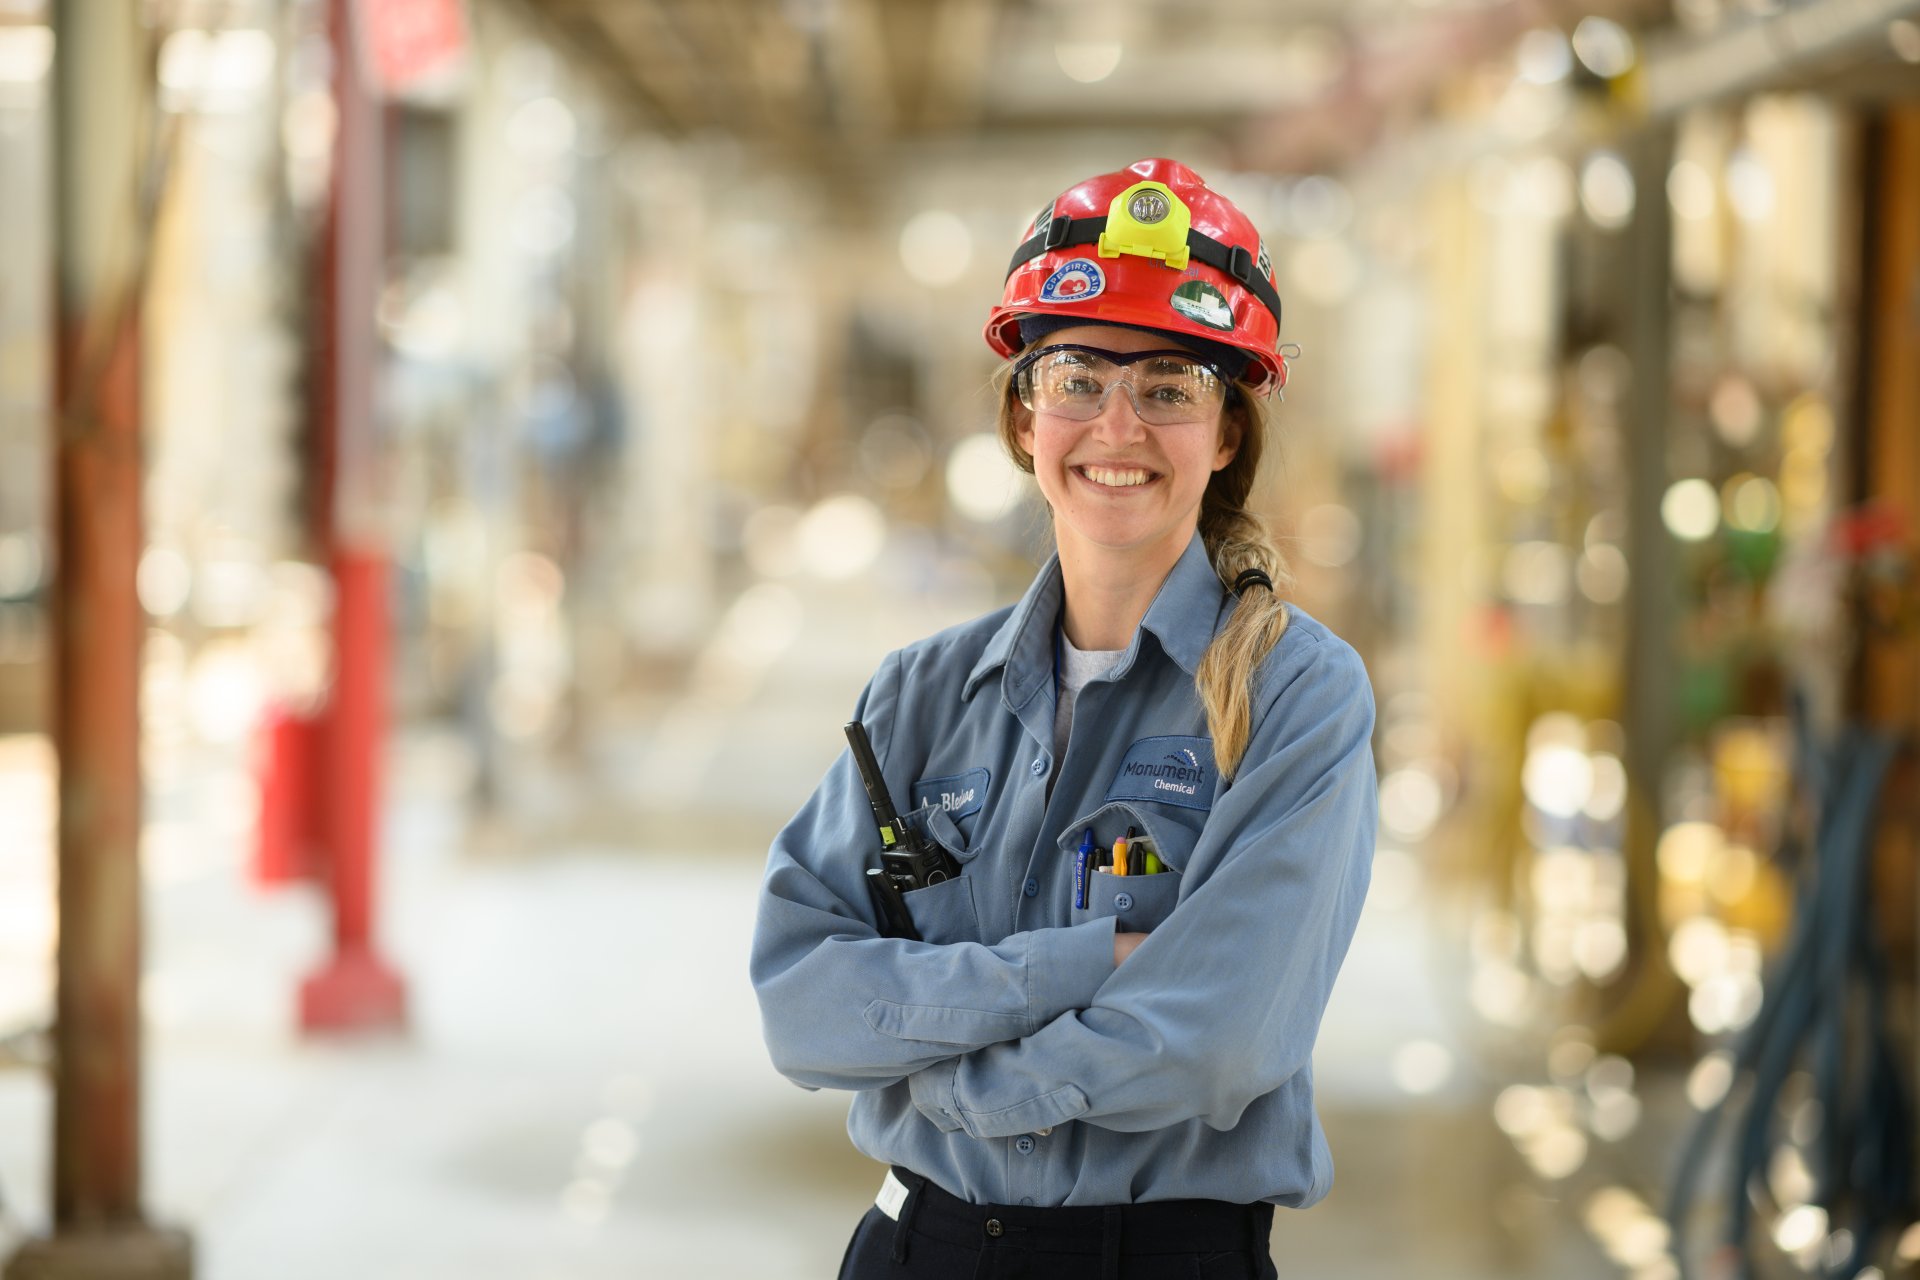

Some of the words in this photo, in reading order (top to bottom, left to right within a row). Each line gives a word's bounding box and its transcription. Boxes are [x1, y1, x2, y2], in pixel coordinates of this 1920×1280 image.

[1046, 272, 1063, 291] CPR
[1065, 263, 1093, 274] FIRST
[1090, 275, 1099, 292] AID
[1124, 761, 1205, 784] Monument
[1154, 779, 1196, 795] Chemical
